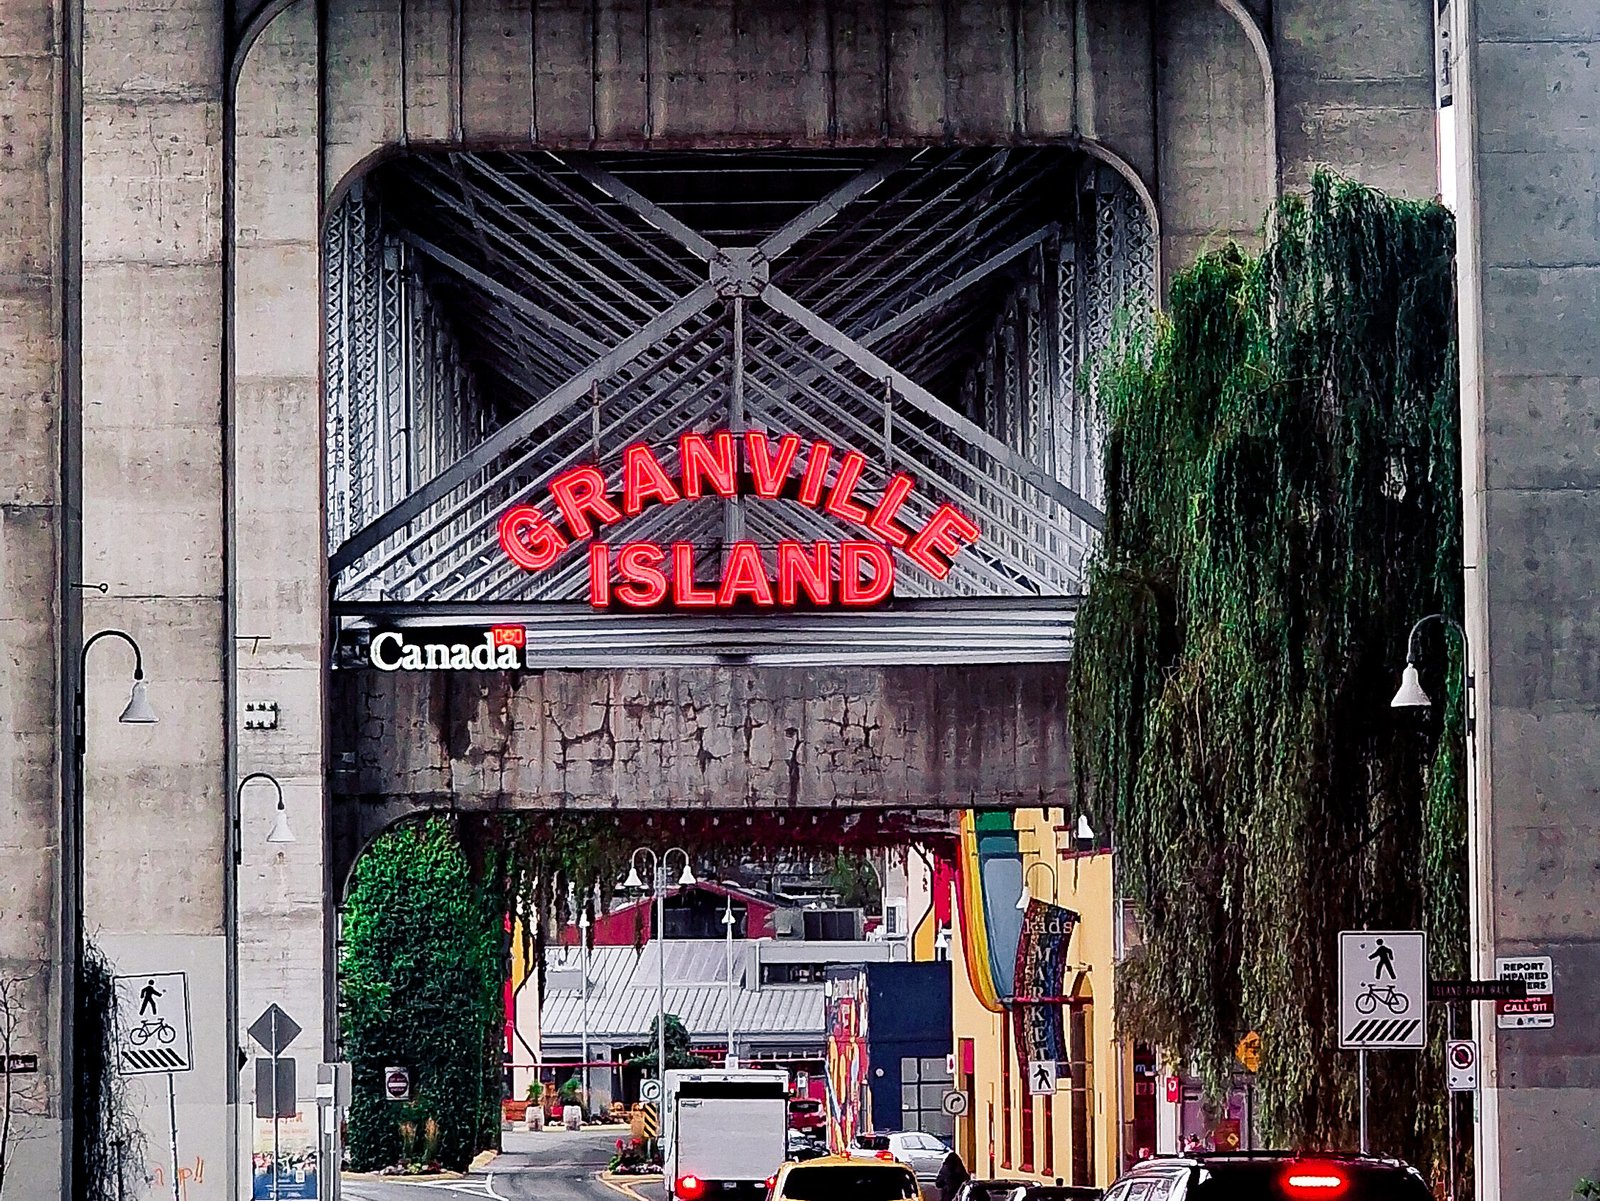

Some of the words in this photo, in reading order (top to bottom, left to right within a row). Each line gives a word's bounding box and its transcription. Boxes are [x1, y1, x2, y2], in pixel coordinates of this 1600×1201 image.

[498, 429, 981, 582] GRANVILLE
[589, 539, 898, 608] ISLAND
[369, 630, 522, 671] Canada
[1023, 917, 1073, 935] kids
[1499, 972, 1549, 982] IMPAIRED
[1503, 962, 1545, 971] REPORT
[1031, 946, 1051, 1062] MARKET
[1503, 1003, 1531, 1013] CALL
[1532, 1002, 1548, 1012] 911
